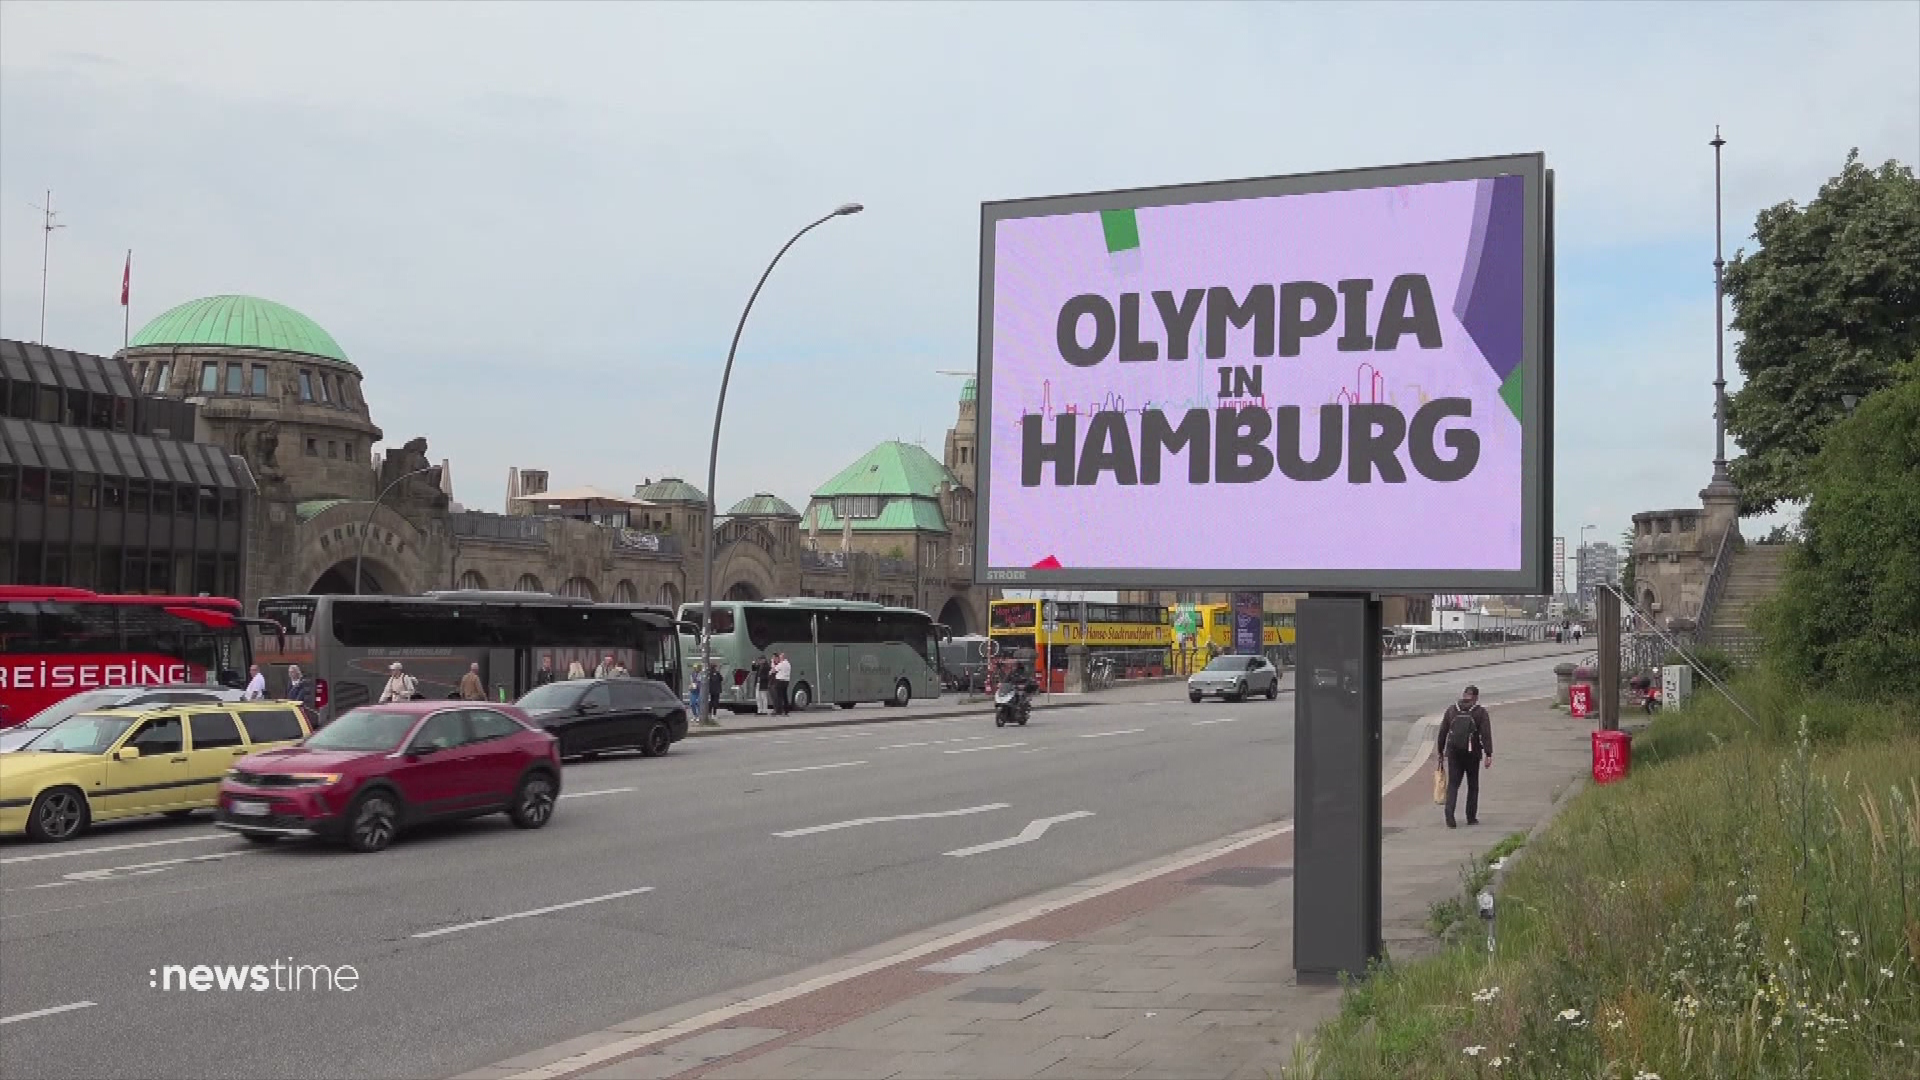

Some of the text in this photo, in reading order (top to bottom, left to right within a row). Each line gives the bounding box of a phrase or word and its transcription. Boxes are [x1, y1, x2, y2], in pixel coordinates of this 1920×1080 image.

[1056, 273, 1442, 367] OLYMPIA
[1217, 364, 1263, 398] IN
[1021, 397, 1481, 487] HAMBURG
